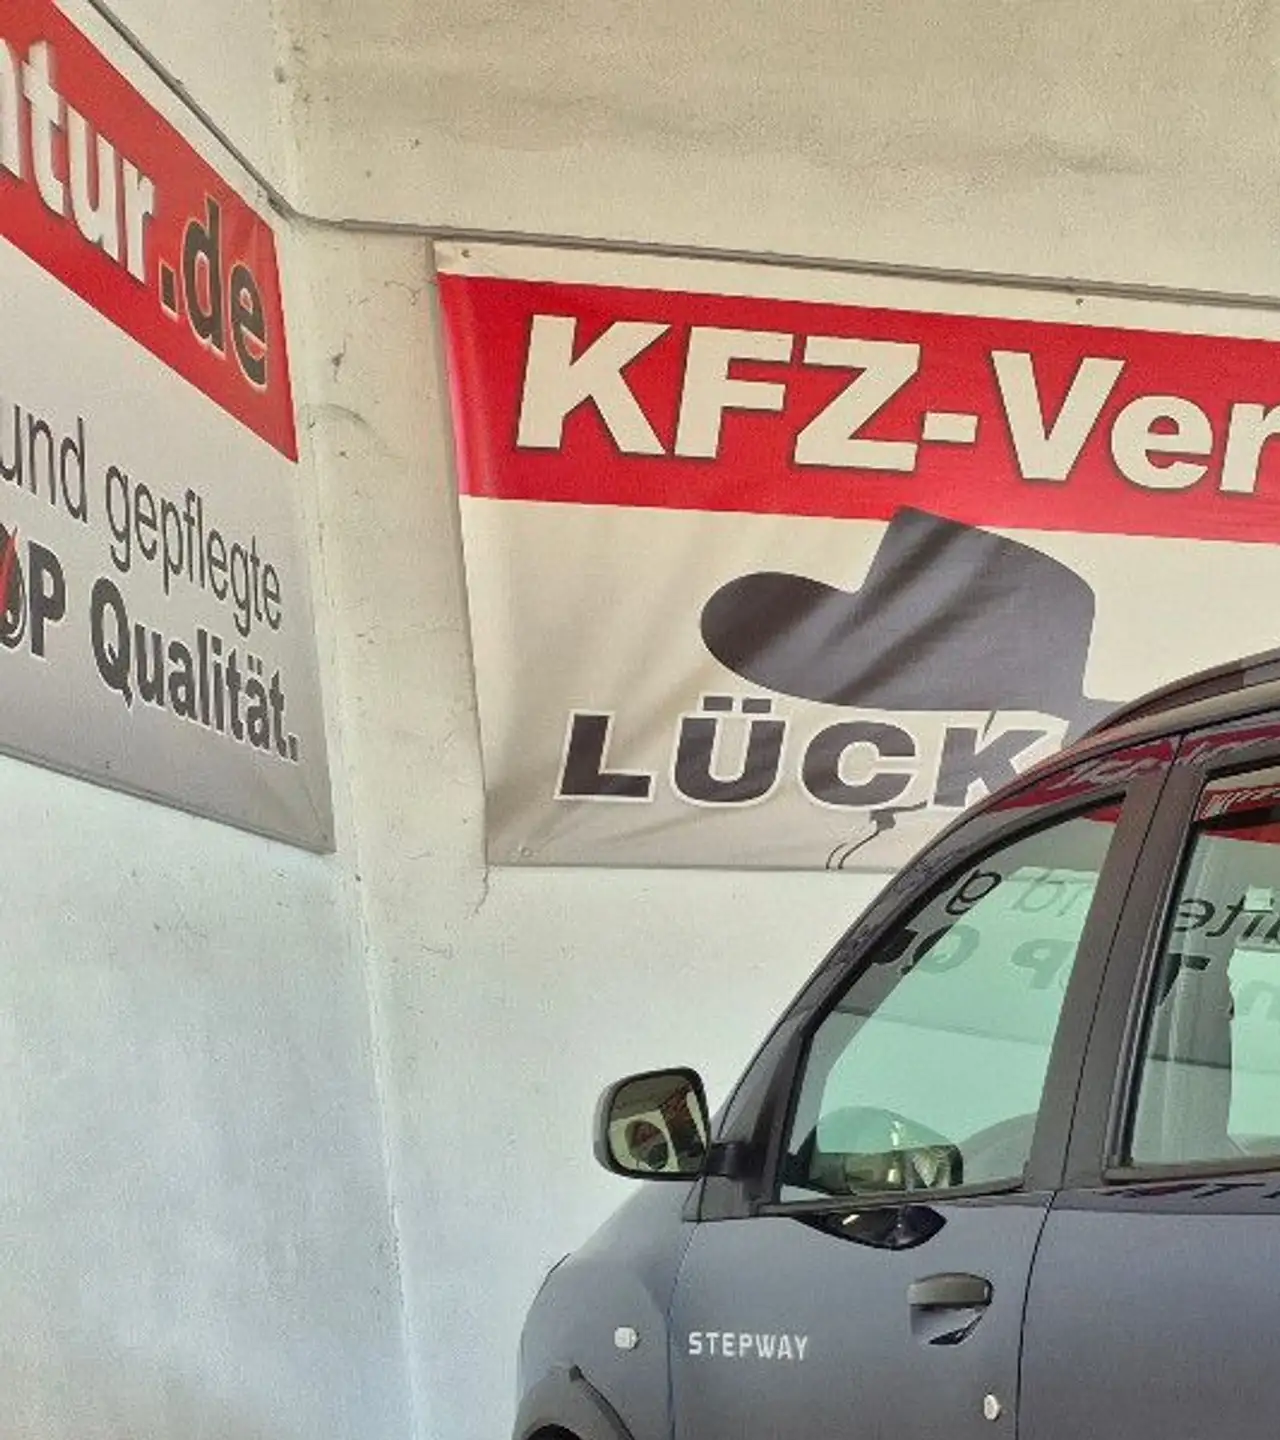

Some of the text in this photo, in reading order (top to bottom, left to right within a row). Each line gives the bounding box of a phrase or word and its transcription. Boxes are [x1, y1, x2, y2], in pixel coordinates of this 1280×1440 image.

[0, 405, 281, 638] und gepflegte
[91, 577, 299, 763] Qualität.
[688, 1331, 809, 1360] STEPWAY
